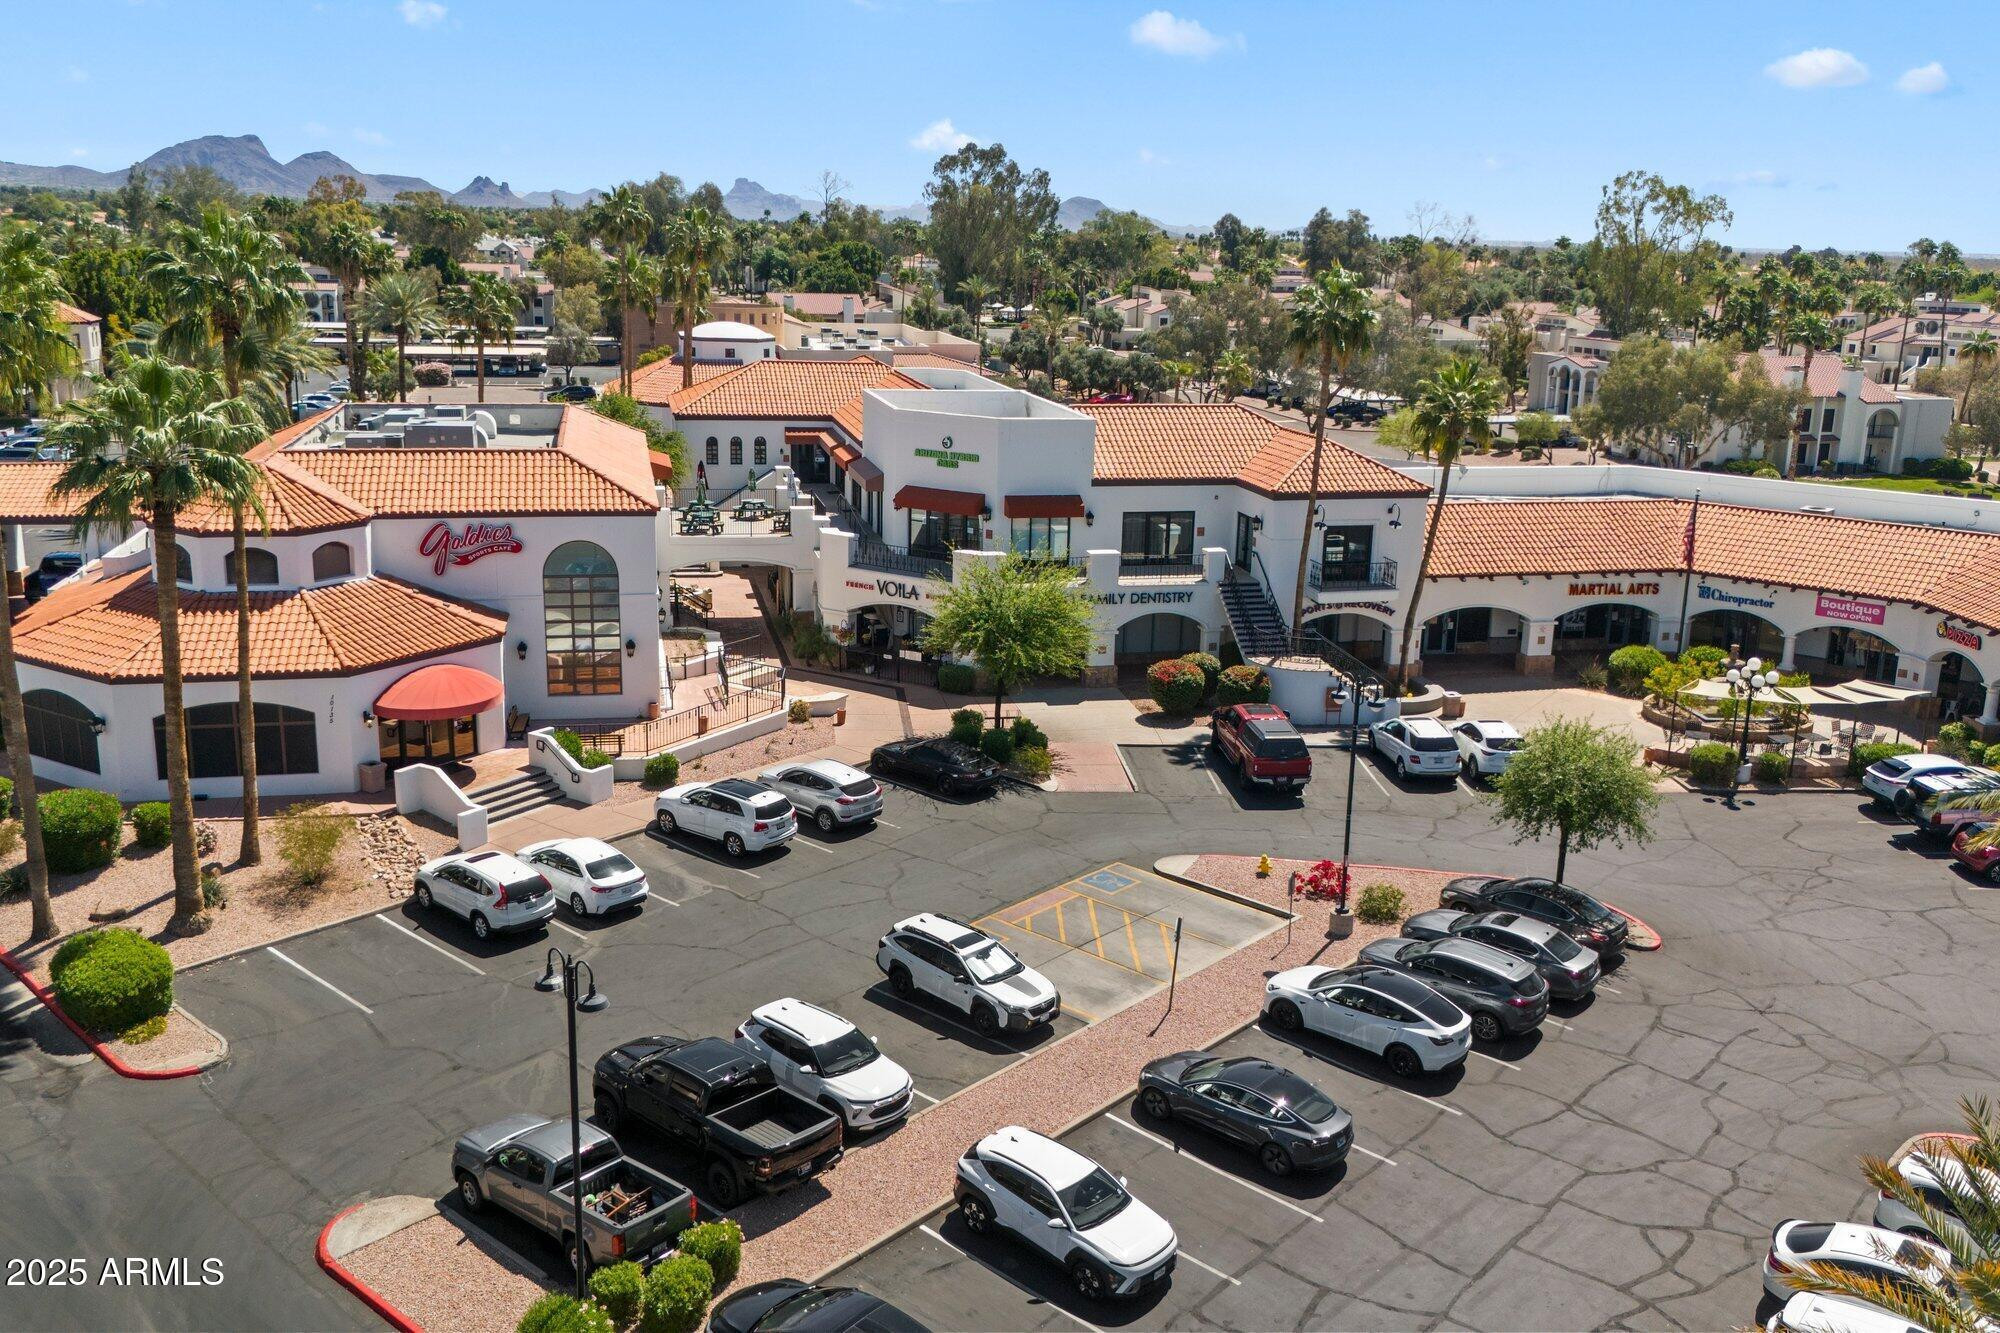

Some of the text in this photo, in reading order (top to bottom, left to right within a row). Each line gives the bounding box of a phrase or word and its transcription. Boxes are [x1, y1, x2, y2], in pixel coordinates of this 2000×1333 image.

[468, 547, 492, 560] SPORTS
[876, 579, 919, 600] VOILA
[1568, 583, 1660, 596] MARTIAL ARTS
[1130, 591, 1194, 605] DENTISTRY
[1711, 588, 1775, 608] Chiropractor
[1301, 601, 1396, 617] PORTS RECOVERY
[1820, 599, 1880, 616] Boutique
[1826, 610, 1872, 622] NOW OPEN
[1946, 626, 1979, 650] PIZZA
